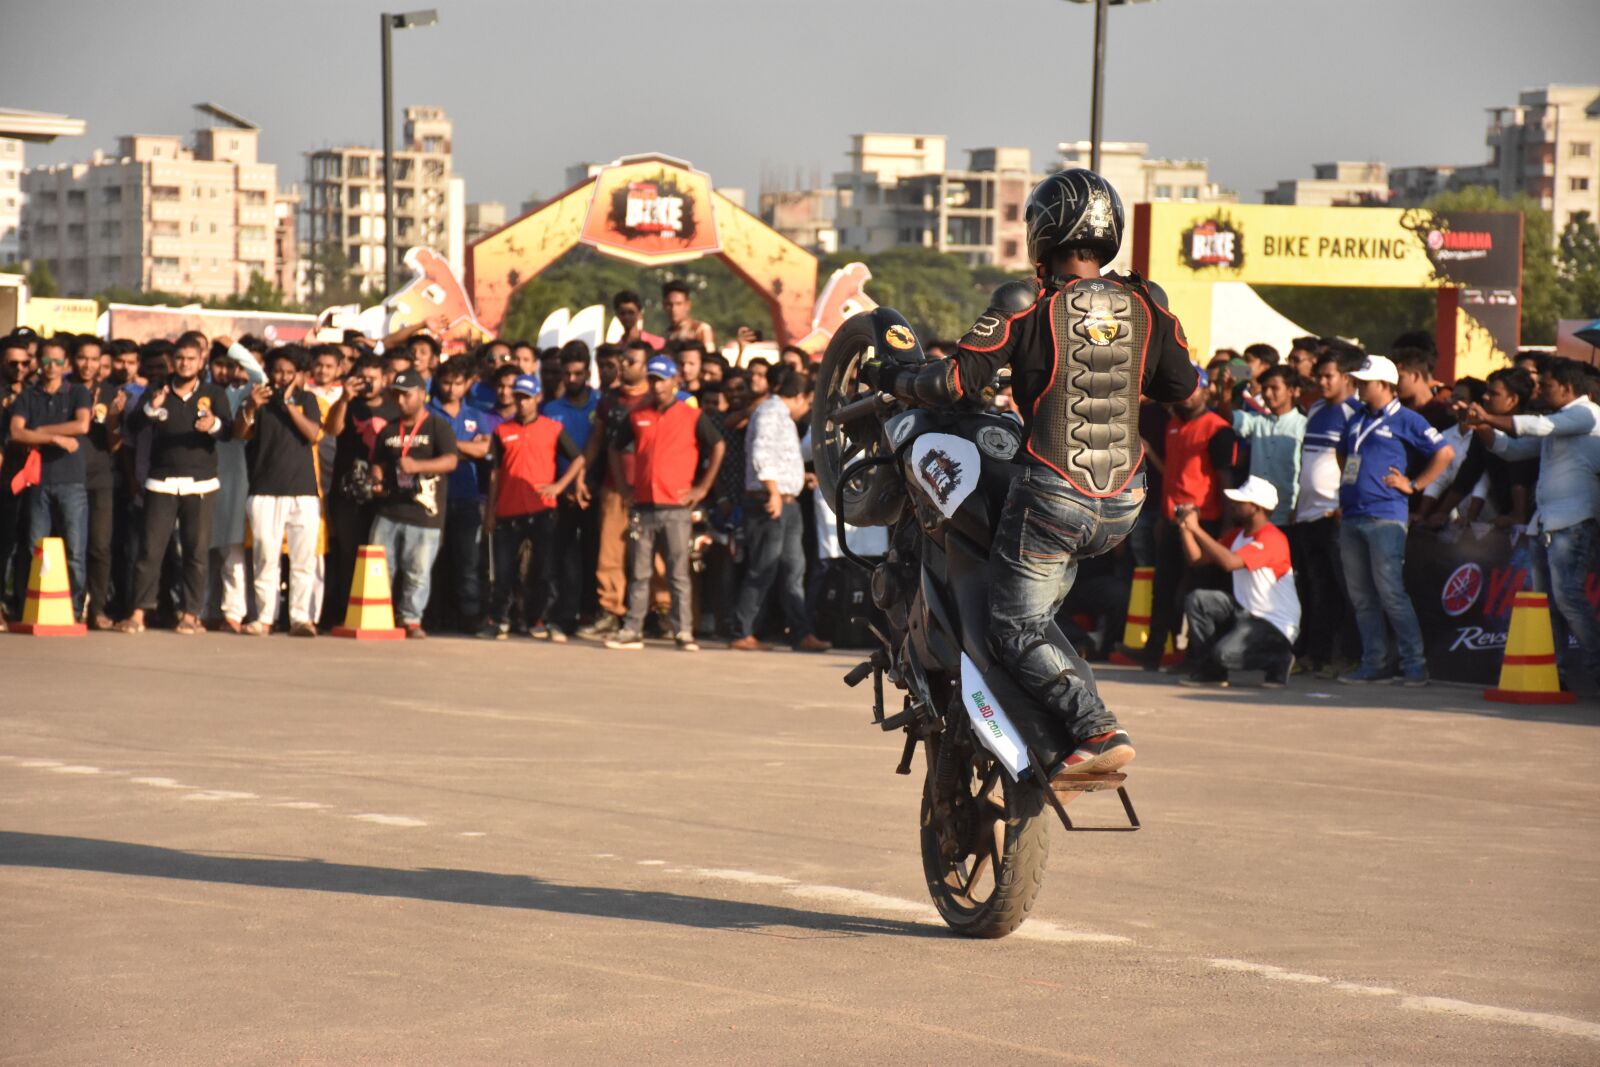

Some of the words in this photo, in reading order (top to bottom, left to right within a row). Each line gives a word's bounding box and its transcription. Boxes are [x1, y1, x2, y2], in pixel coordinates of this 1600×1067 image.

[1264, 236, 1309, 257] BIKE
[1318, 237, 1406, 260] PARKING
[971, 690, 1003, 739] BikeBD.com
